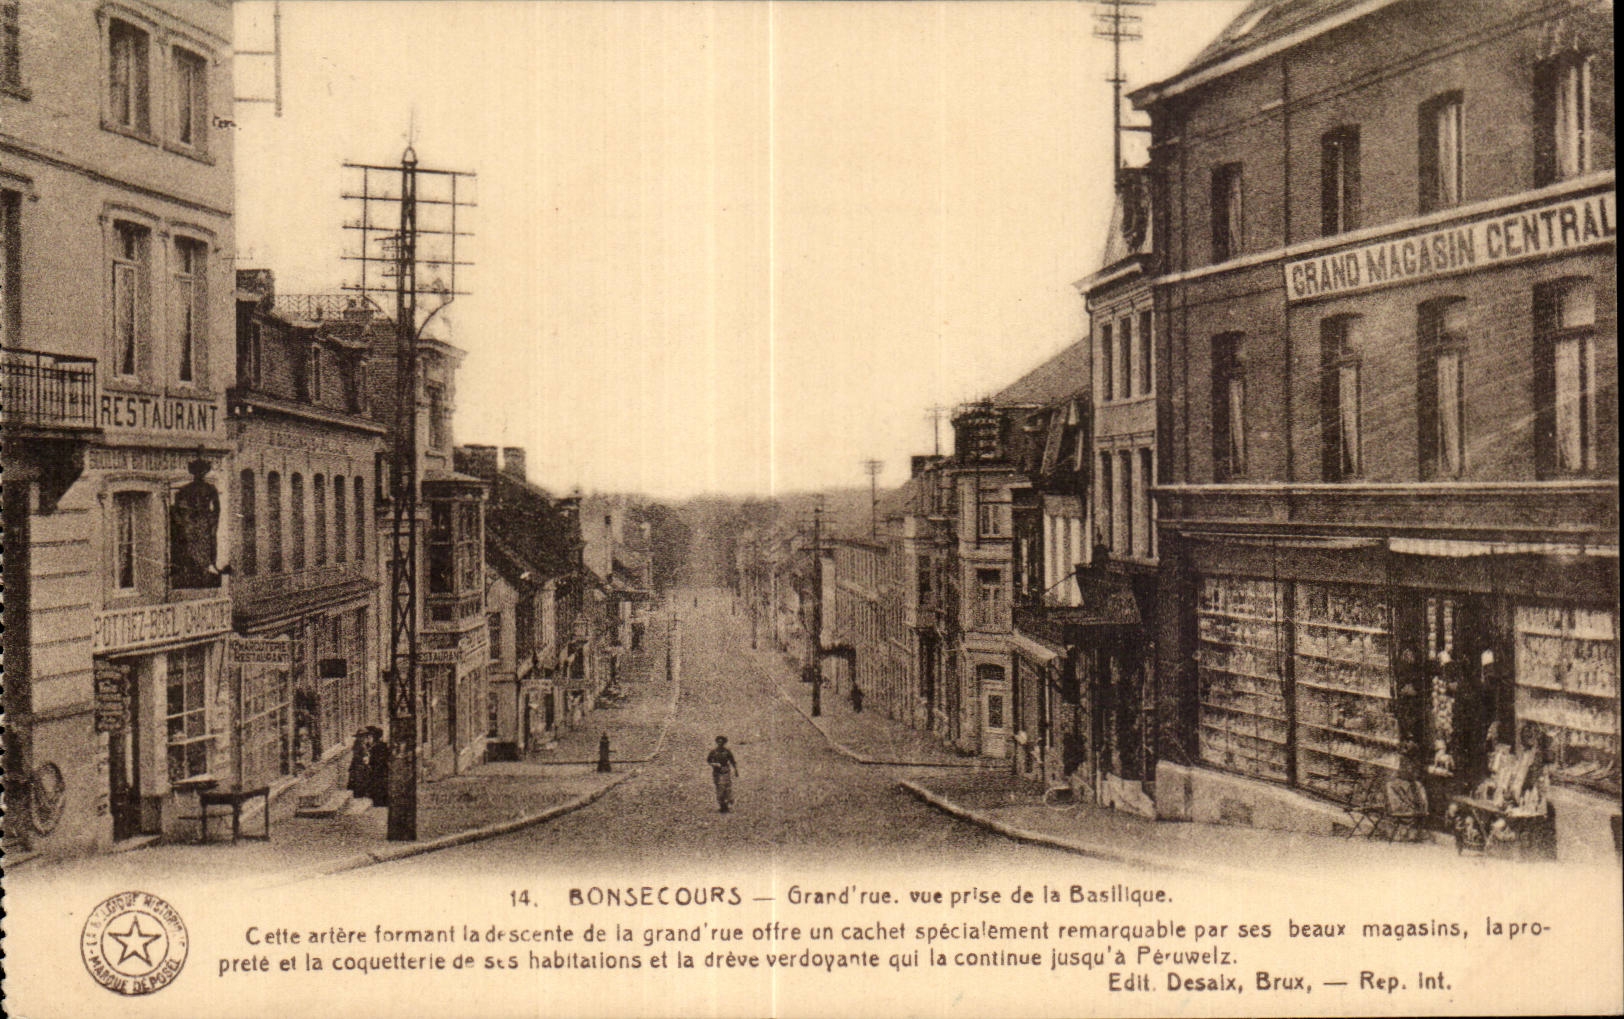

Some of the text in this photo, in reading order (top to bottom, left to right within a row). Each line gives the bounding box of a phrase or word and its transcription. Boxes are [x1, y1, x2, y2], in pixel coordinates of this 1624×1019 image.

[1291, 195, 1616, 297] GRAND MAGASIN CENTRAL
[101, 395, 218, 432] RESTAURANT
[233, 652, 289, 664] RESTAURANT
